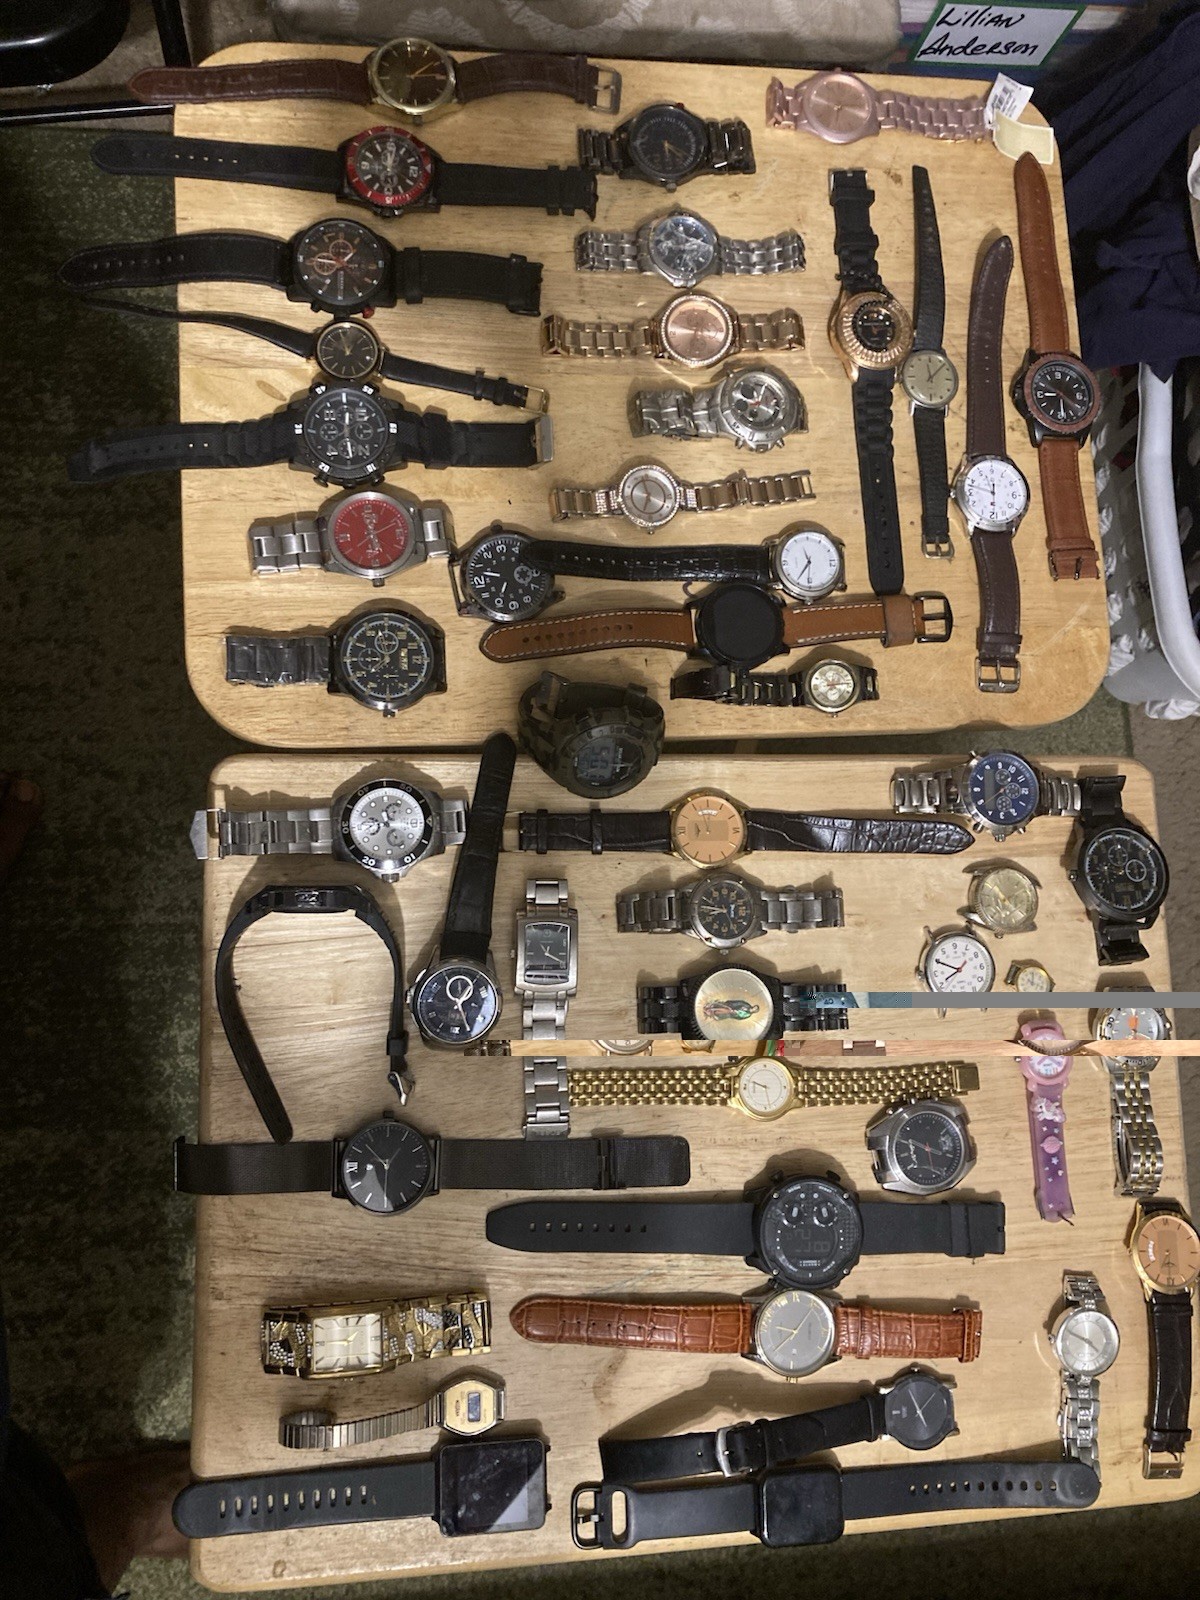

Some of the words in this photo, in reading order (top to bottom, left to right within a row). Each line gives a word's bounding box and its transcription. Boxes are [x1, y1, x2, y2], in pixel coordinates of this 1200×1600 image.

[1036, 390, 1044, 399] 3
[318, 462, 330, 473] 20
[366, 462, 377, 473] 10
[989, 511, 998, 519] 12
[495, 544, 507, 553] 3
[482, 551, 493, 559] 2
[473, 575, 486, 589] 12
[494, 597, 504, 608] 10
[522, 595, 532, 603] 8
[508, 600, 519, 610] 9
[1007, 765, 1017, 773] 10
[1021, 787, 1029, 795] 12
[341, 820, 349, 834] 30
[362, 856, 376, 866] 20
[404, 853, 416, 864] 10
